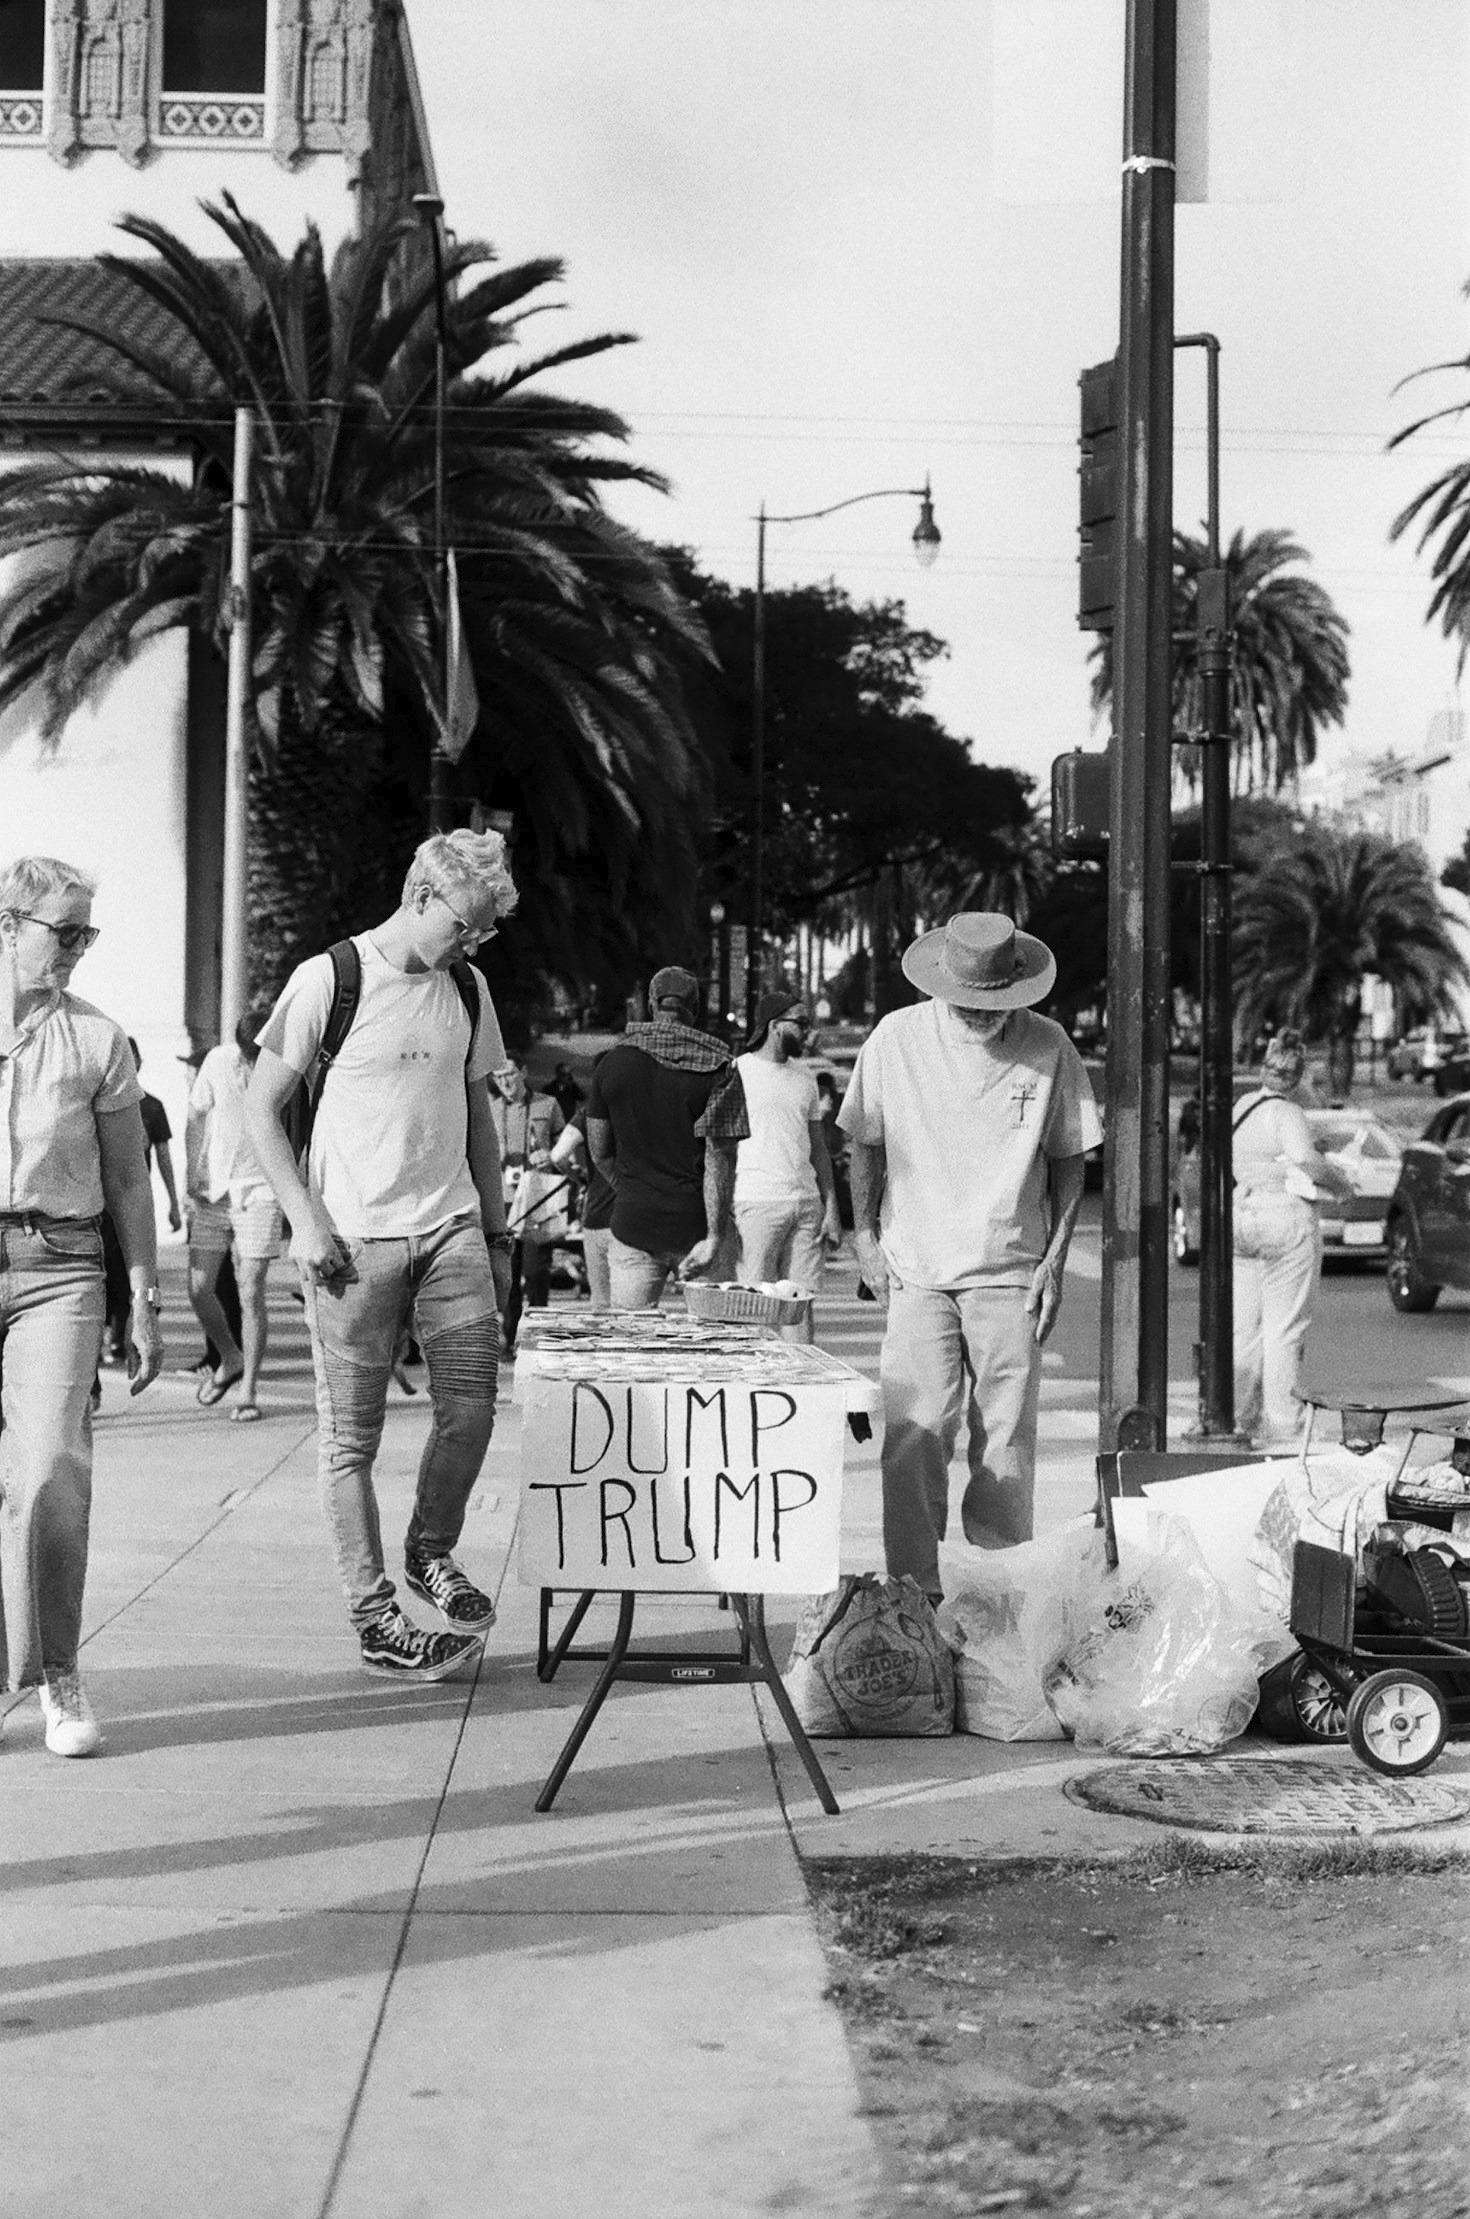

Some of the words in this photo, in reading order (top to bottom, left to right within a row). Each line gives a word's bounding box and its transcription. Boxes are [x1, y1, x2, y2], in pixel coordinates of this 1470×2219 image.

[570, 1382, 798, 1475] DUMP
[529, 1469, 818, 1570] TRUMP
[843, 1650, 913, 1680] TRADER
[857, 1669, 908, 1695] JOE'S
